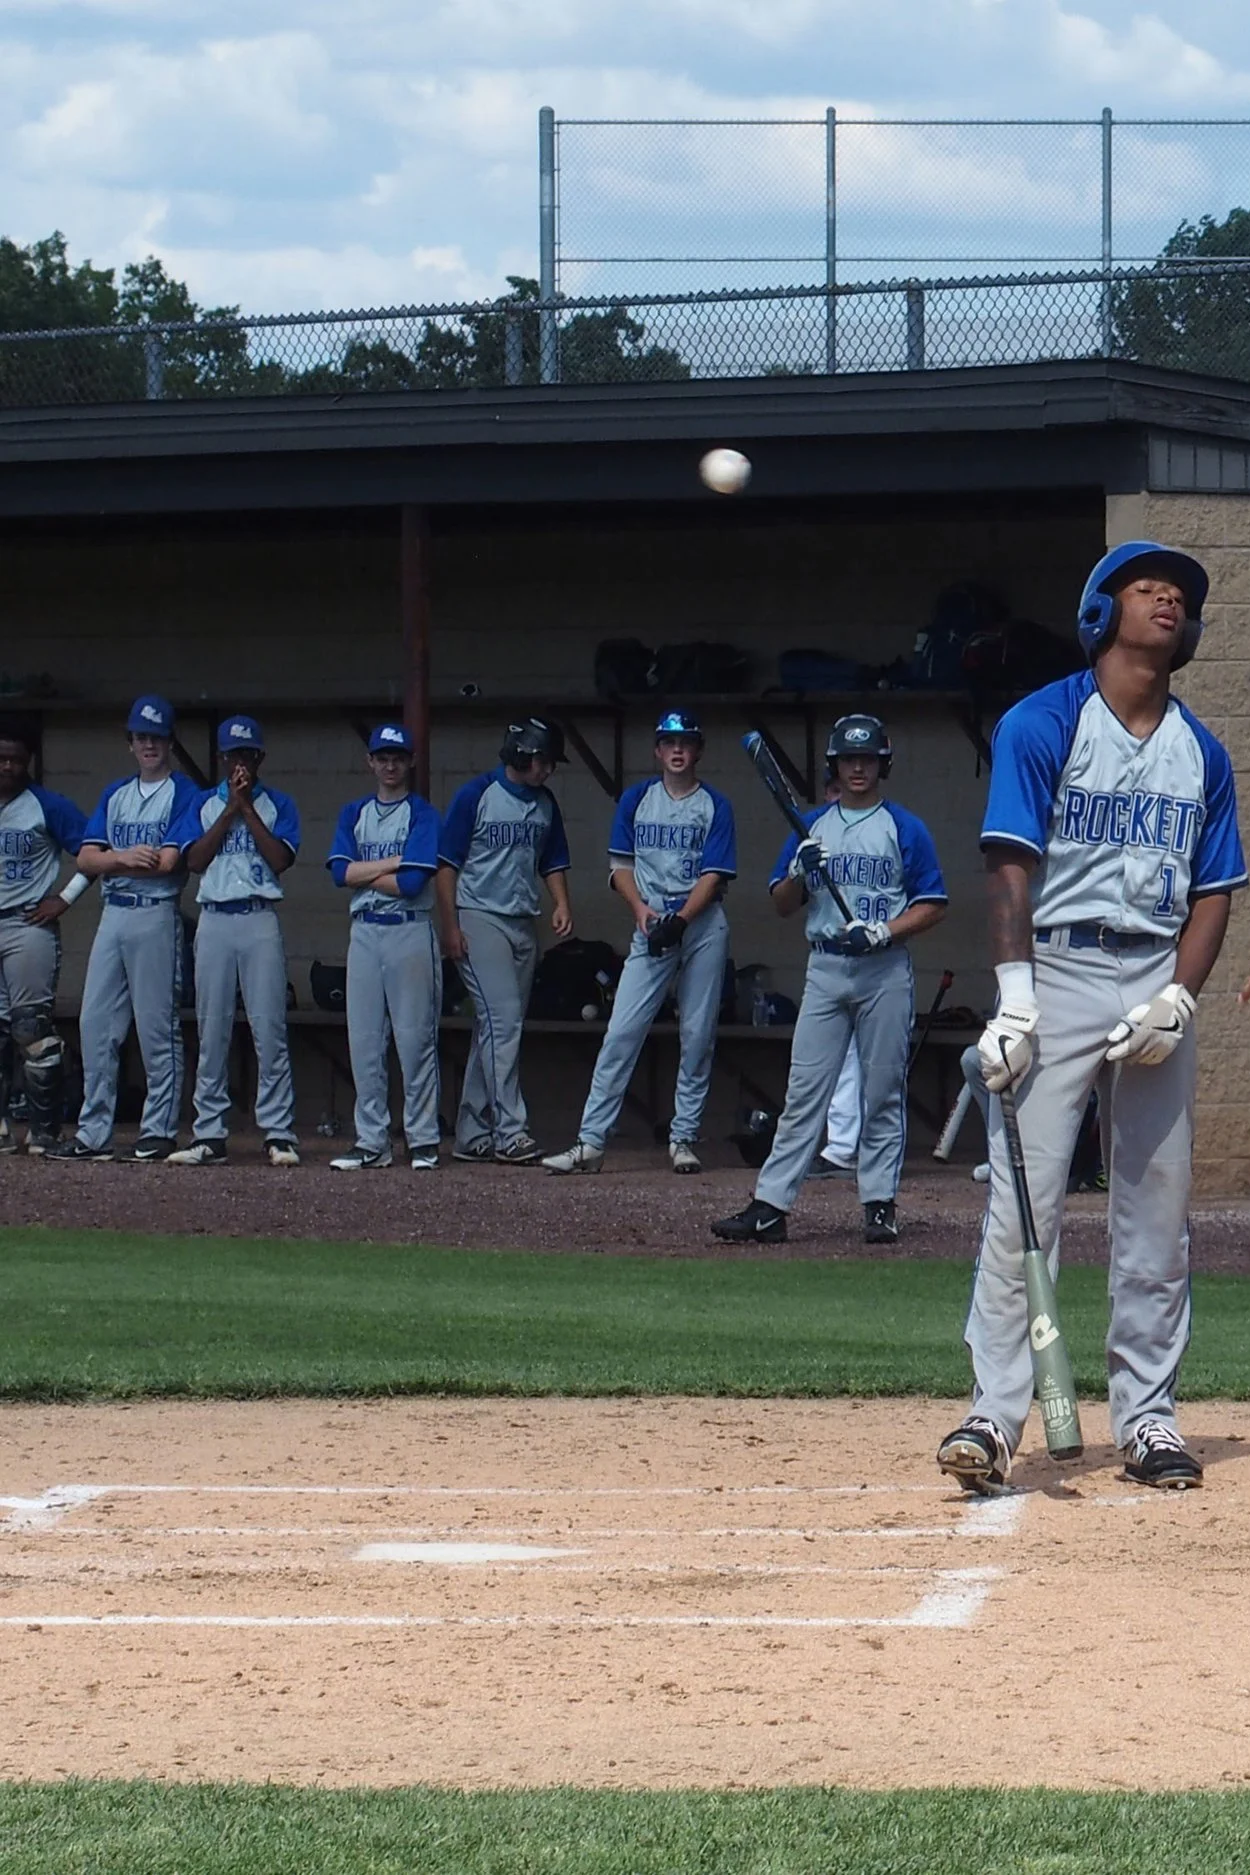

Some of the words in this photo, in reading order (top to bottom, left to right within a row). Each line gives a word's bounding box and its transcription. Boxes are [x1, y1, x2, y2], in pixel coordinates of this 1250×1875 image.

[0, 829, 34, 856] ETS
[5, 859, 34, 882] 32
[250, 863, 264, 887] 3
[806, 853, 894, 891] RCKETS
[1152, 863, 1176, 917] 1
[856, 894, 890, 924] 36
